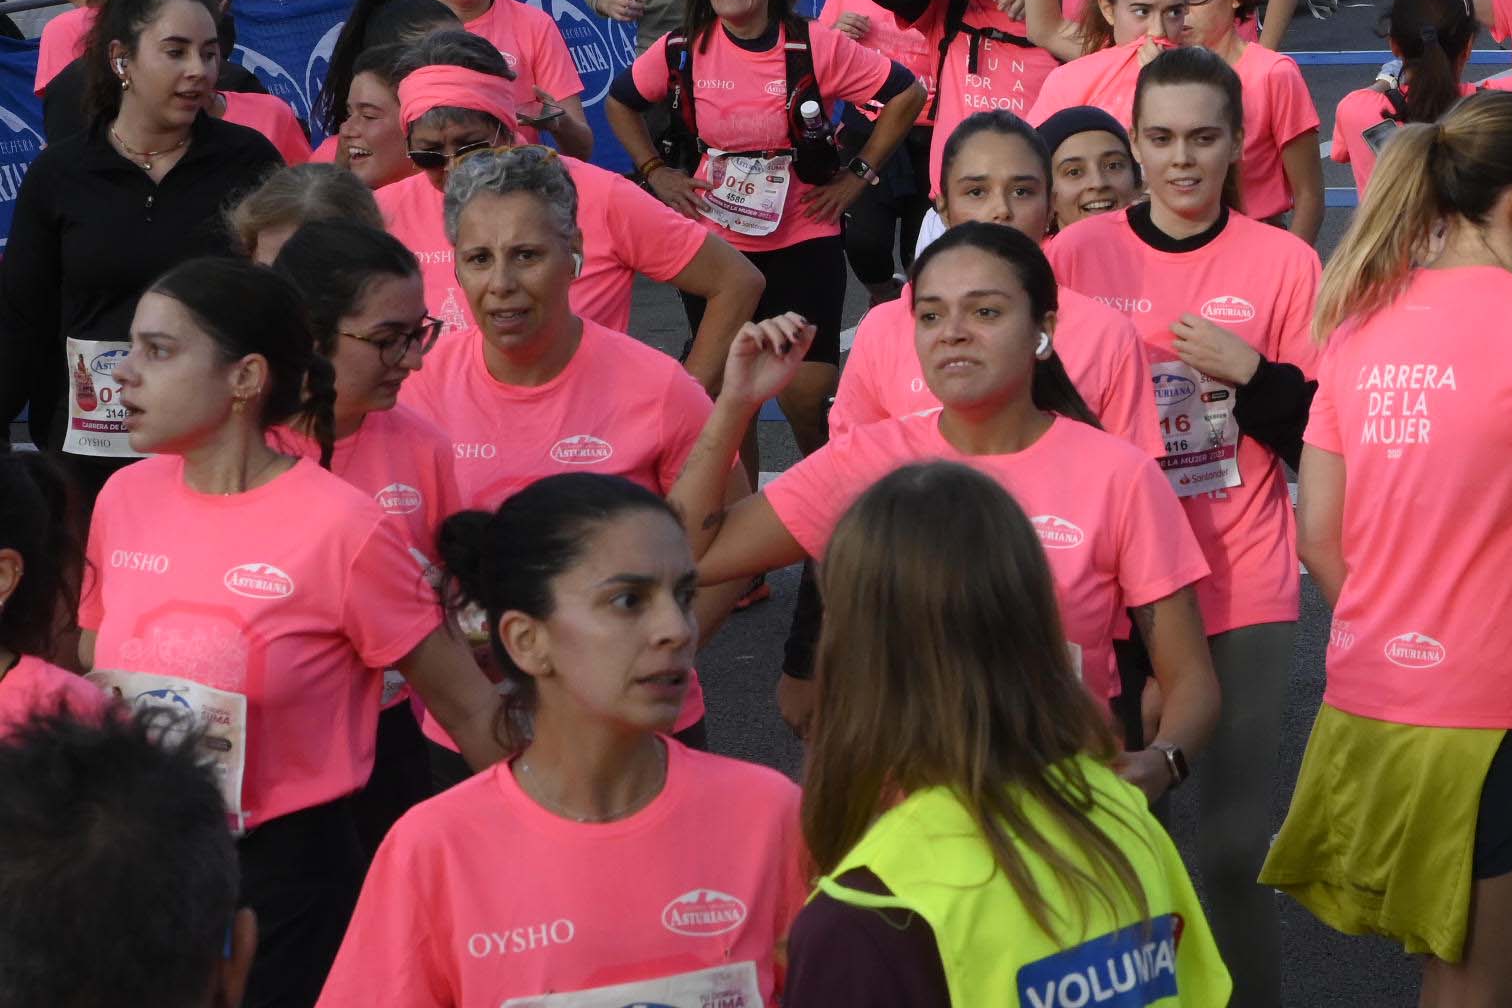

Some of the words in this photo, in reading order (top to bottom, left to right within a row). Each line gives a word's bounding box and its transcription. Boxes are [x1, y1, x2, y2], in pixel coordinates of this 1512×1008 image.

[569, 42, 610, 75] IANA
[697, 79, 735, 90] OYSHO
[965, 73, 991, 90] FOR
[1012, 77, 1024, 91] A
[964, 93, 1024, 111] REASON
[0, 139, 34, 154] ECHERA
[726, 175, 755, 195] 016
[416, 249, 454, 263] OYSH
[1205, 303, 1251, 318] ASTURIANA
[1154, 385, 1192, 400] TURIANA
[1368, 390, 1395, 417] DE
[1402, 390, 1428, 417] LA
[1159, 413, 1191, 435] 16
[1360, 418, 1432, 445] MUJER
[551, 444, 609, 460] ASTURIANA
[1191, 468, 1229, 484] Santander
[1034, 528, 1079, 544] URIANA
[110, 548, 169, 575] OYSHO
[228, 573, 291, 594] ASTURIANA
[1330, 631, 1354, 651] SHO
[1388, 641, 1441, 663] ASTURIANA
[670, 906, 741, 928] ASTURIANA
[468, 918, 574, 958] OYSHO
